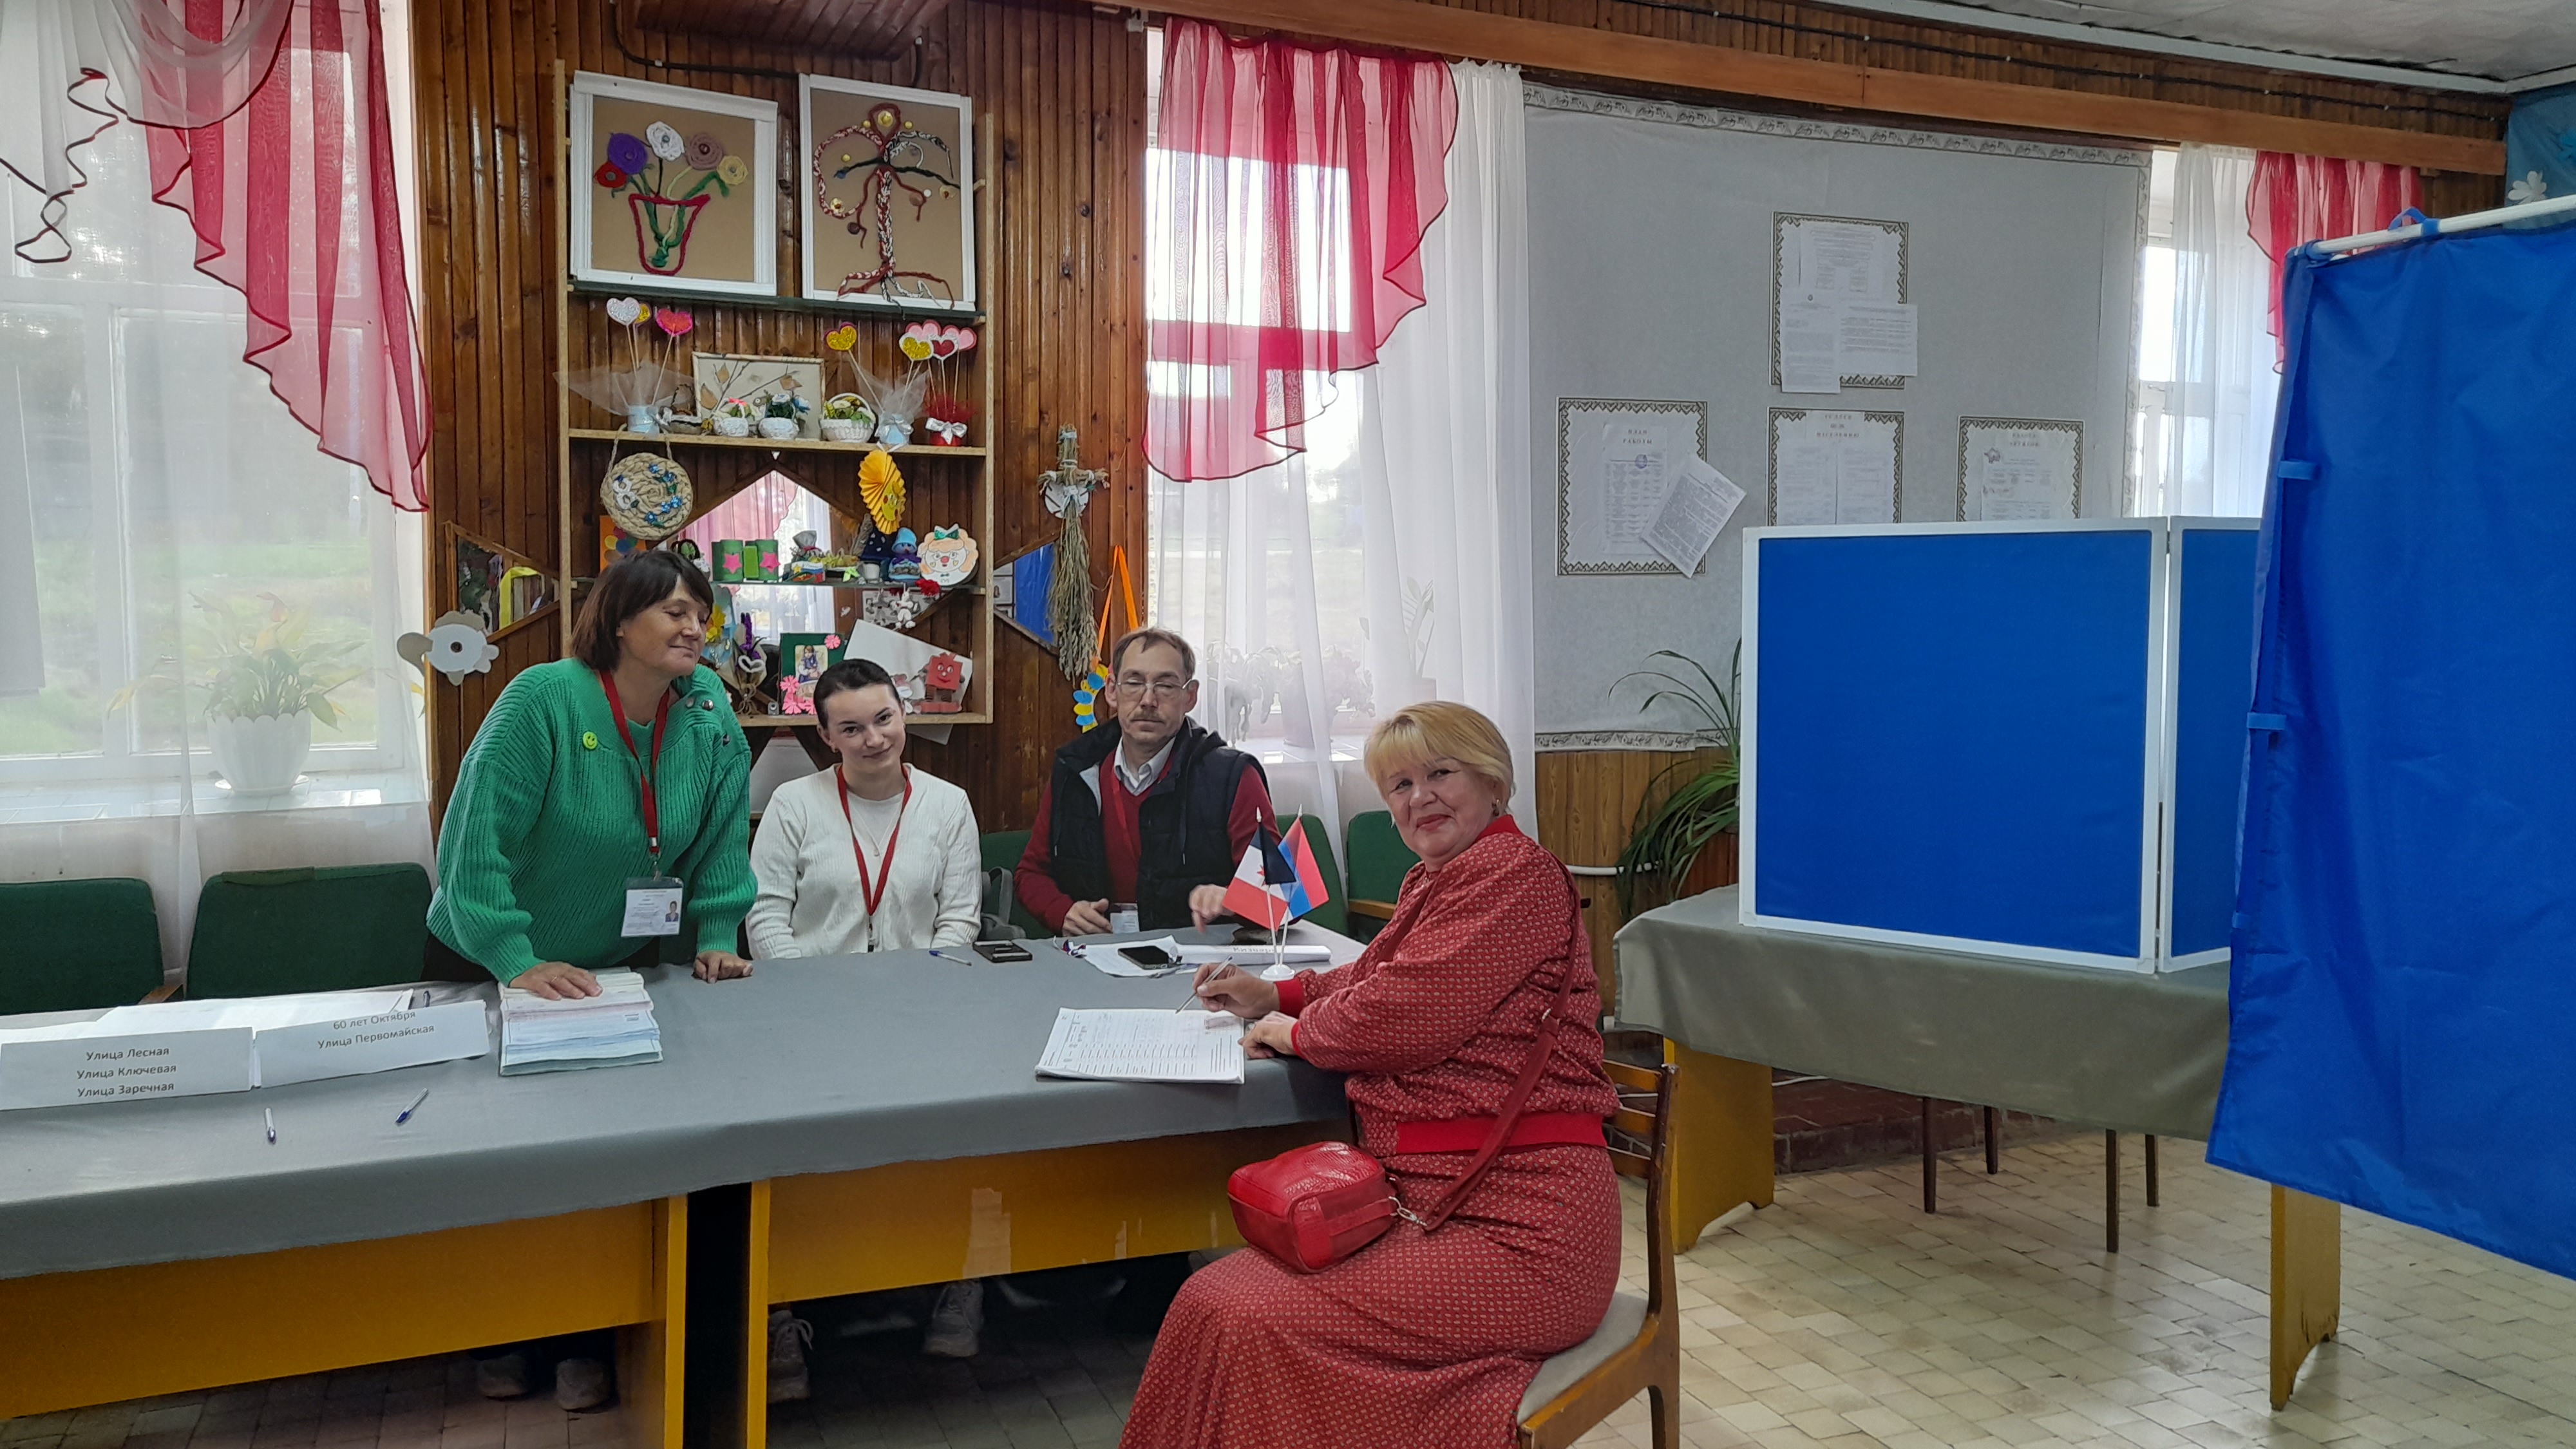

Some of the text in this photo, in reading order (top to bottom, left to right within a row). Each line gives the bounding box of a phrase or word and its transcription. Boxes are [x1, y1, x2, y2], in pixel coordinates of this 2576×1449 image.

[333, 1011, 415, 1030] 60 лет Октября
[317, 1025, 435, 1049] Улица Первомайская
[86, 1048, 169, 1061] Улица Лесная
[77, 1065, 176, 1079] Улица Ключевая
[77, 1083, 175, 1097] Улица Заречная
